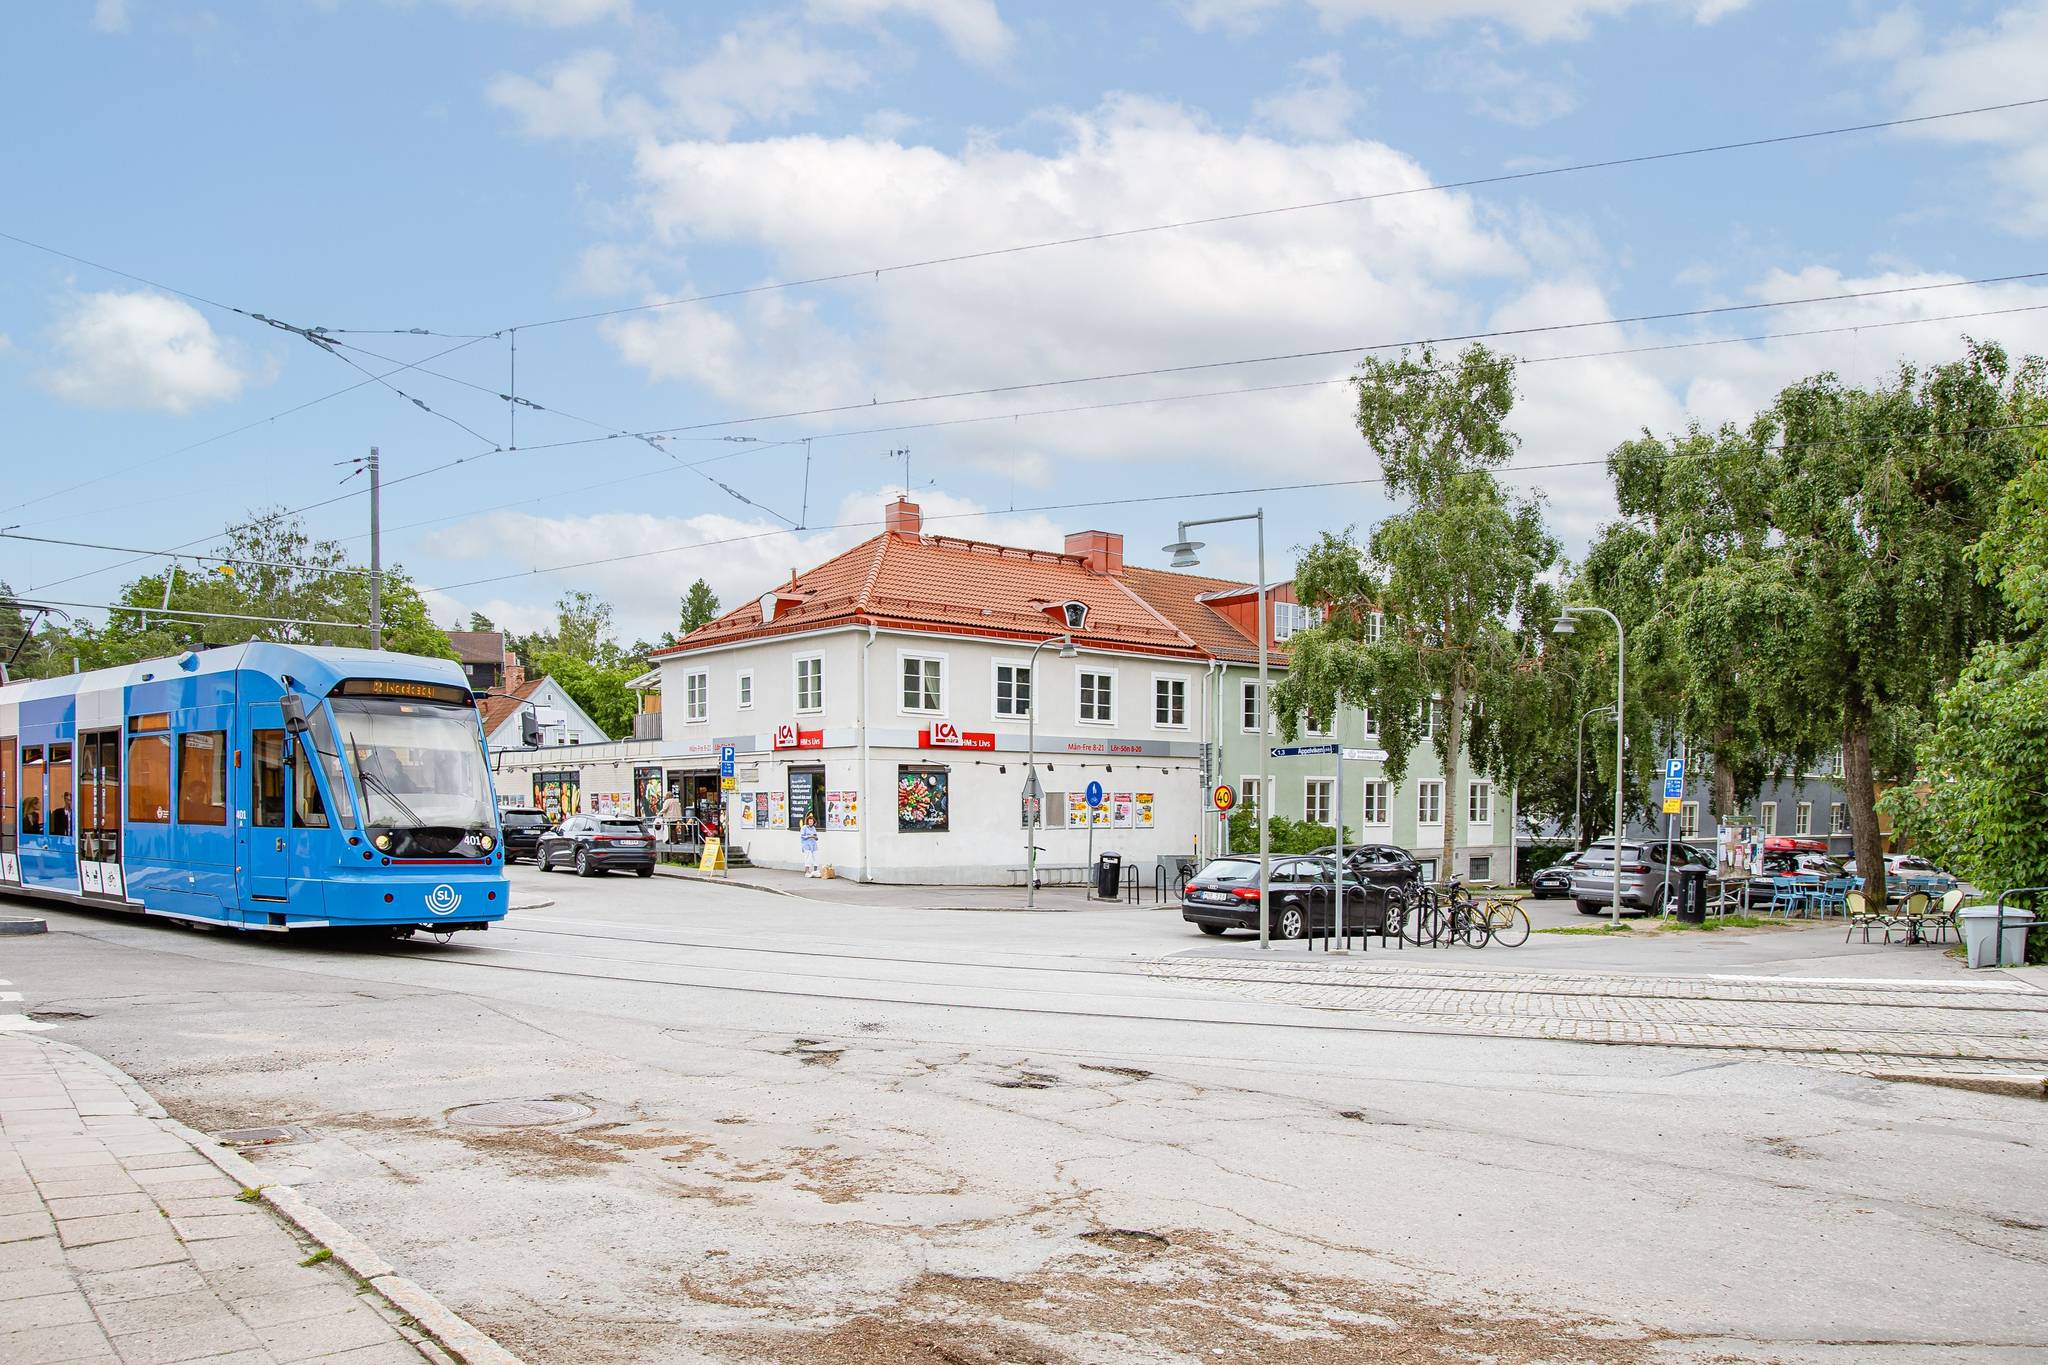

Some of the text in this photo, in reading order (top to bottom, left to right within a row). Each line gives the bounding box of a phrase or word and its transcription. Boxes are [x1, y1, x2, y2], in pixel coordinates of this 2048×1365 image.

[779, 724, 793, 740] ICA
[935, 723, 958, 738] ICA
[978, 739, 991, 747] Livs
[724, 748, 733, 761] P
[1670, 761, 1681, 777] P
[1216, 791, 1229, 803] 40
[236, 810, 247, 820] 401
[464, 836, 481, 846] 401
[437, 890, 451, 901] SL
